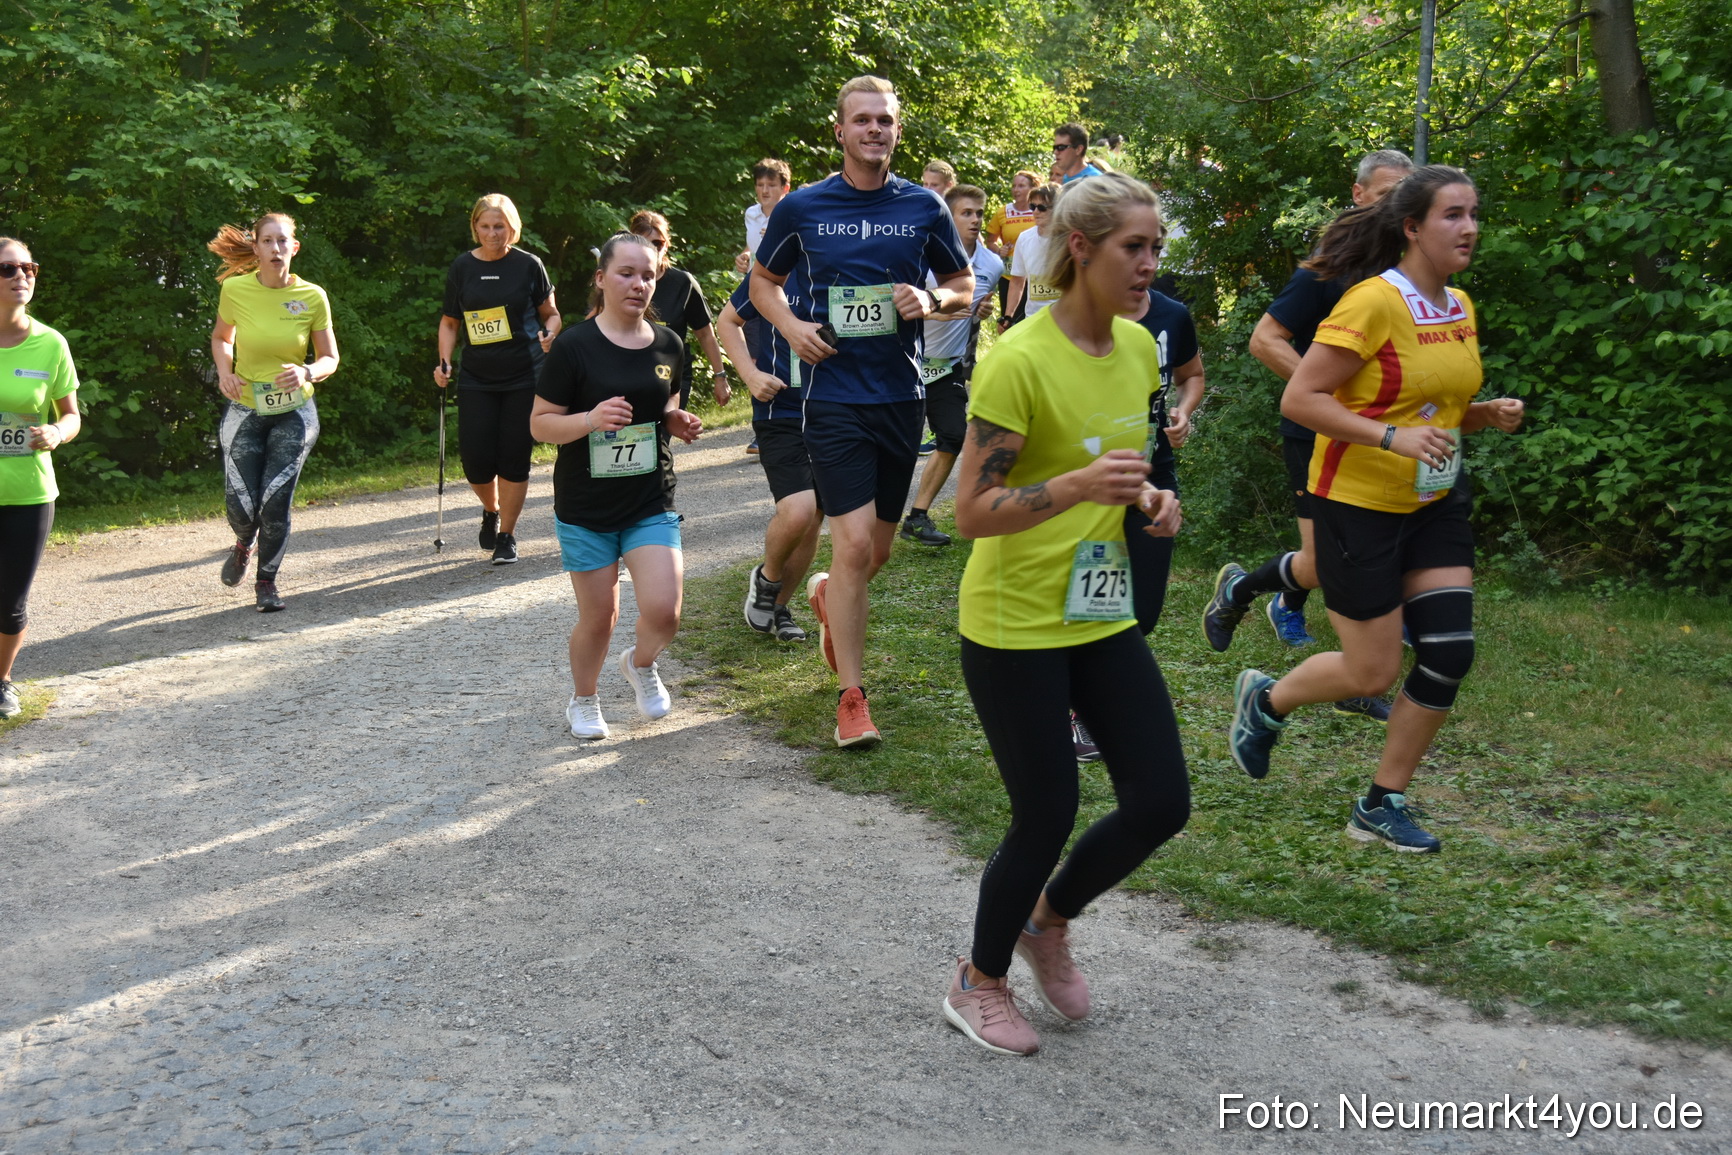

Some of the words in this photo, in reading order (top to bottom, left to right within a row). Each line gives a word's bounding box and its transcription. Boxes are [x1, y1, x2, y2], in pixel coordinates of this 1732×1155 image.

[818, 224, 858, 236] EURO
[874, 224, 916, 237] POLES
[843, 304, 882, 322] 703
[472, 320, 501, 335] 1967
[1416, 330, 1451, 346] MAX
[1452, 324, 1478, 340] BÖGL
[264, 392, 292, 406] 671
[612, 444, 636, 462] 77
[1081, 570, 1126, 598] 1275
